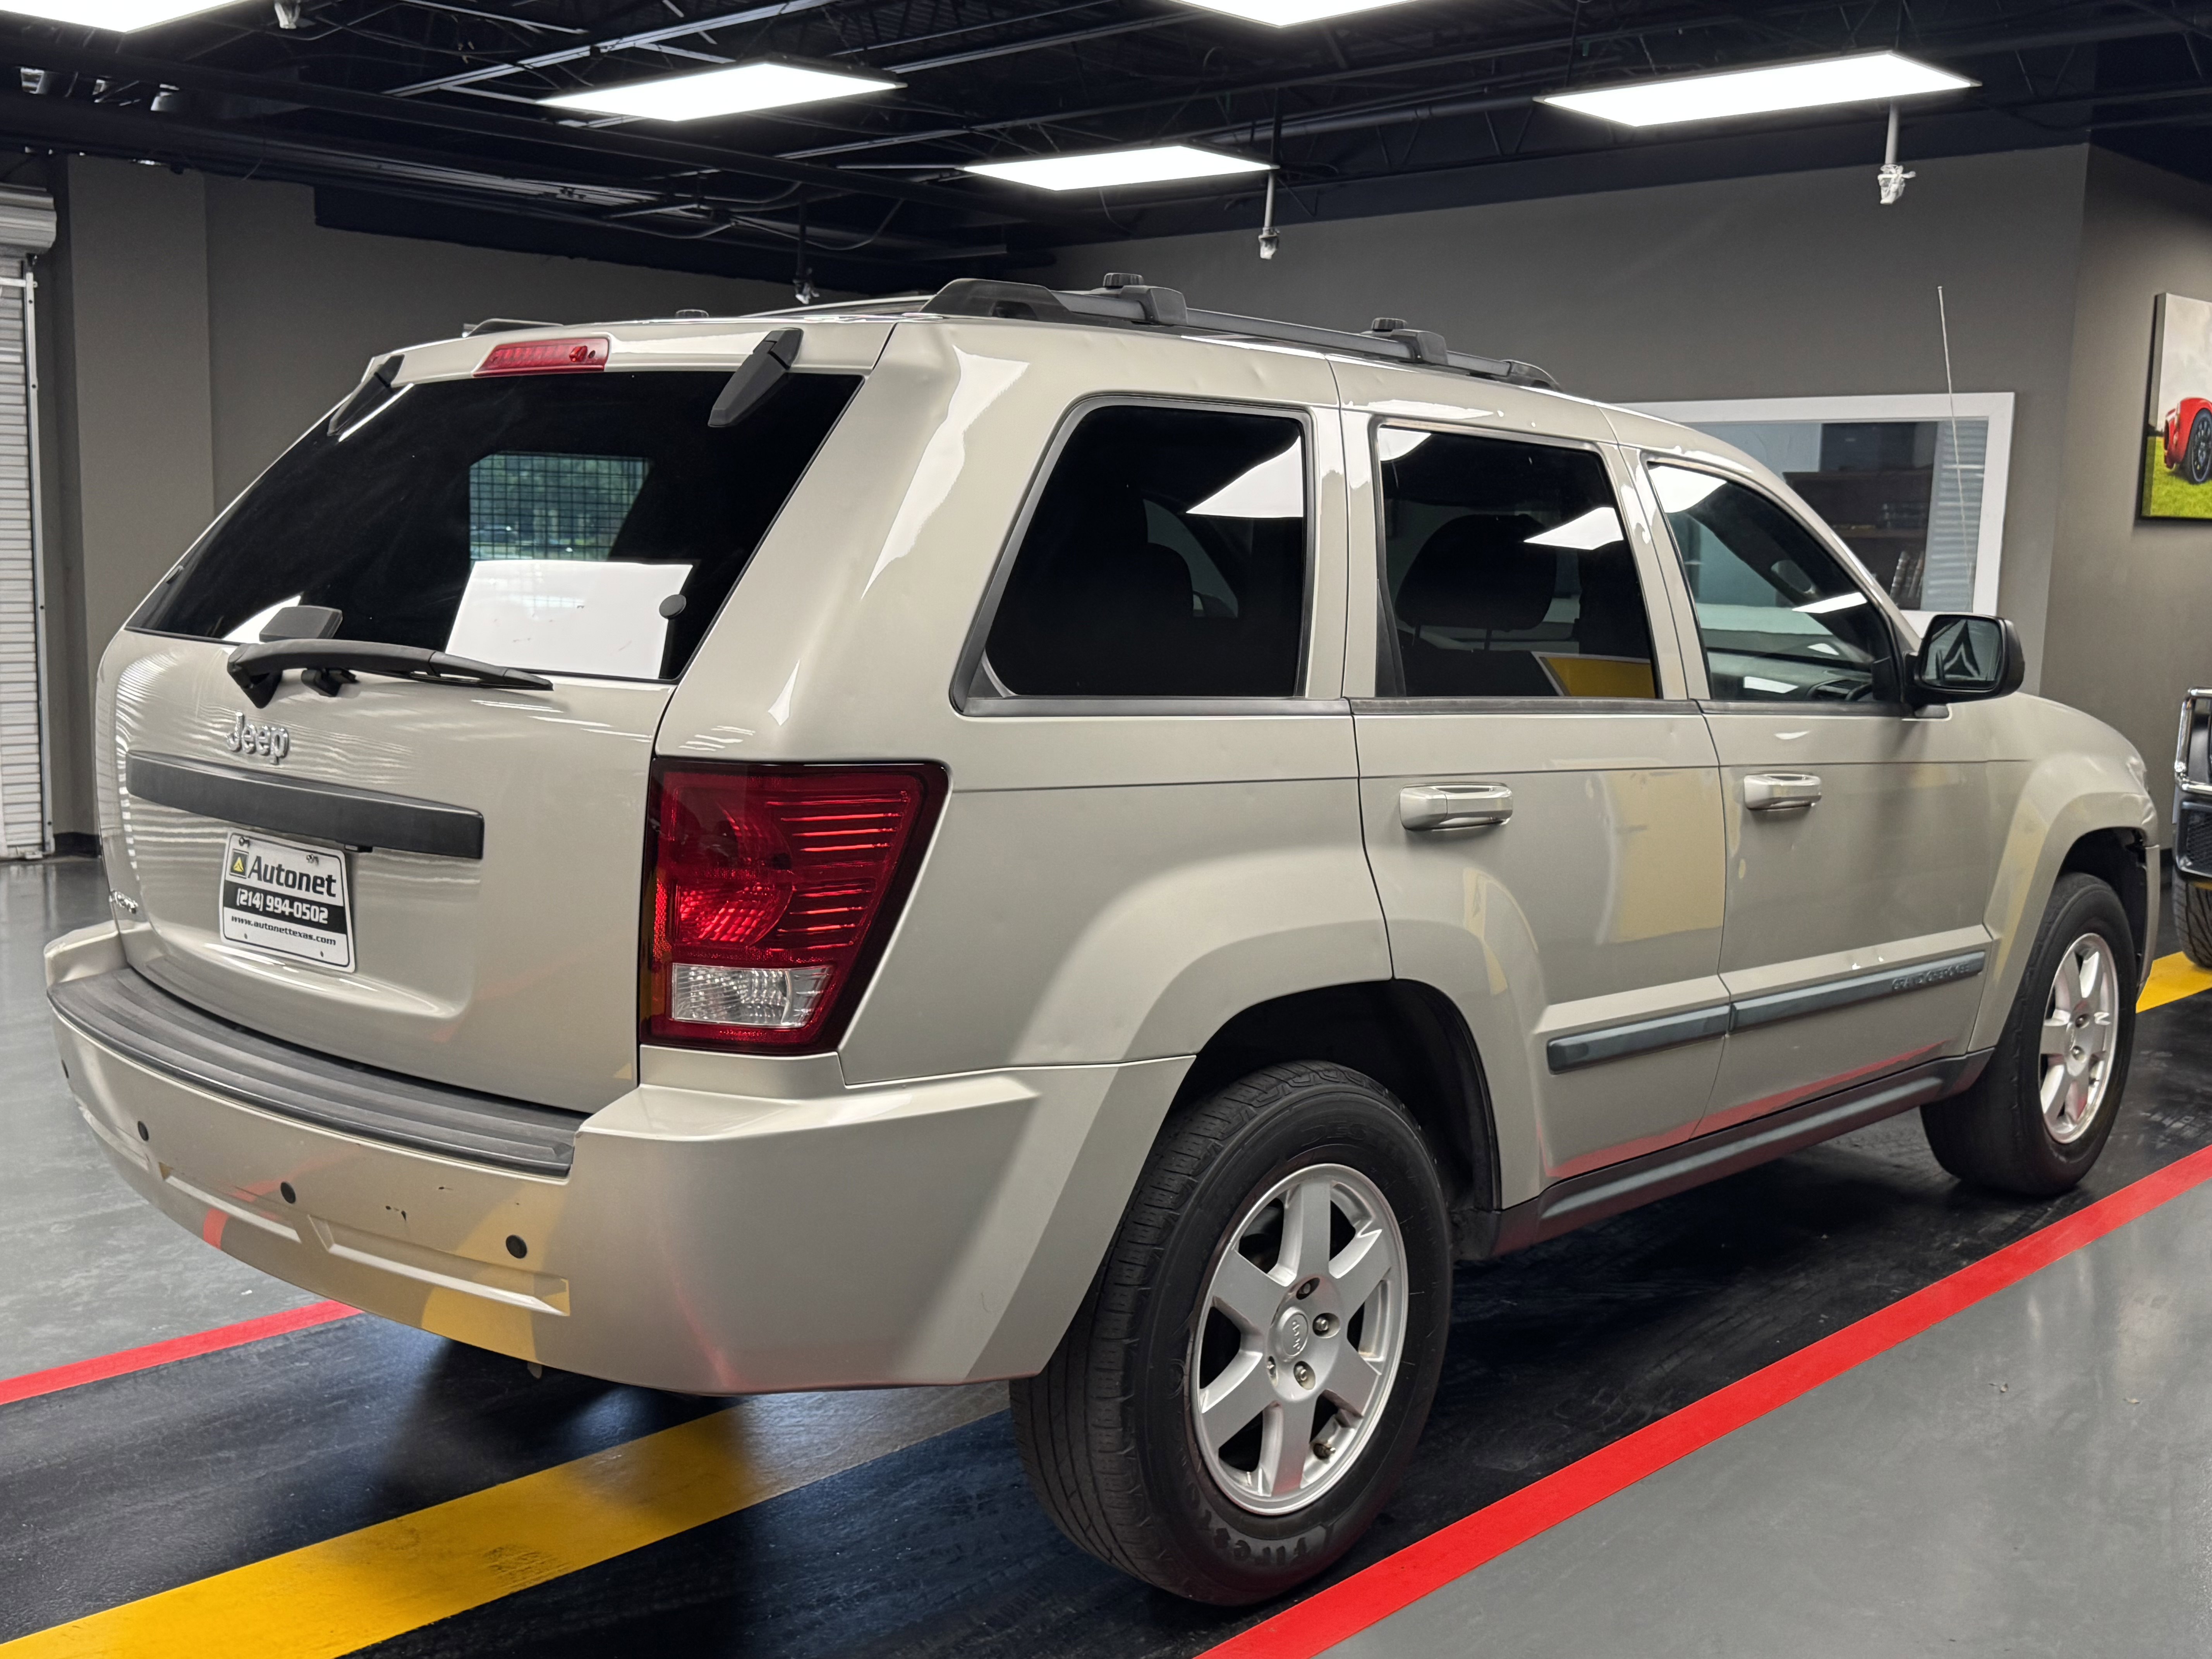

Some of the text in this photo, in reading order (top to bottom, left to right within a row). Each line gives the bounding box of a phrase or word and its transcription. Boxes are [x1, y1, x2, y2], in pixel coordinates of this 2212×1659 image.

[227, 711, 289, 765] Jeep
[248, 855, 337, 898] Autonet
[236, 888, 328, 924] (214) 994-0502
[232, 916, 336, 945] www.autonettexas.com
